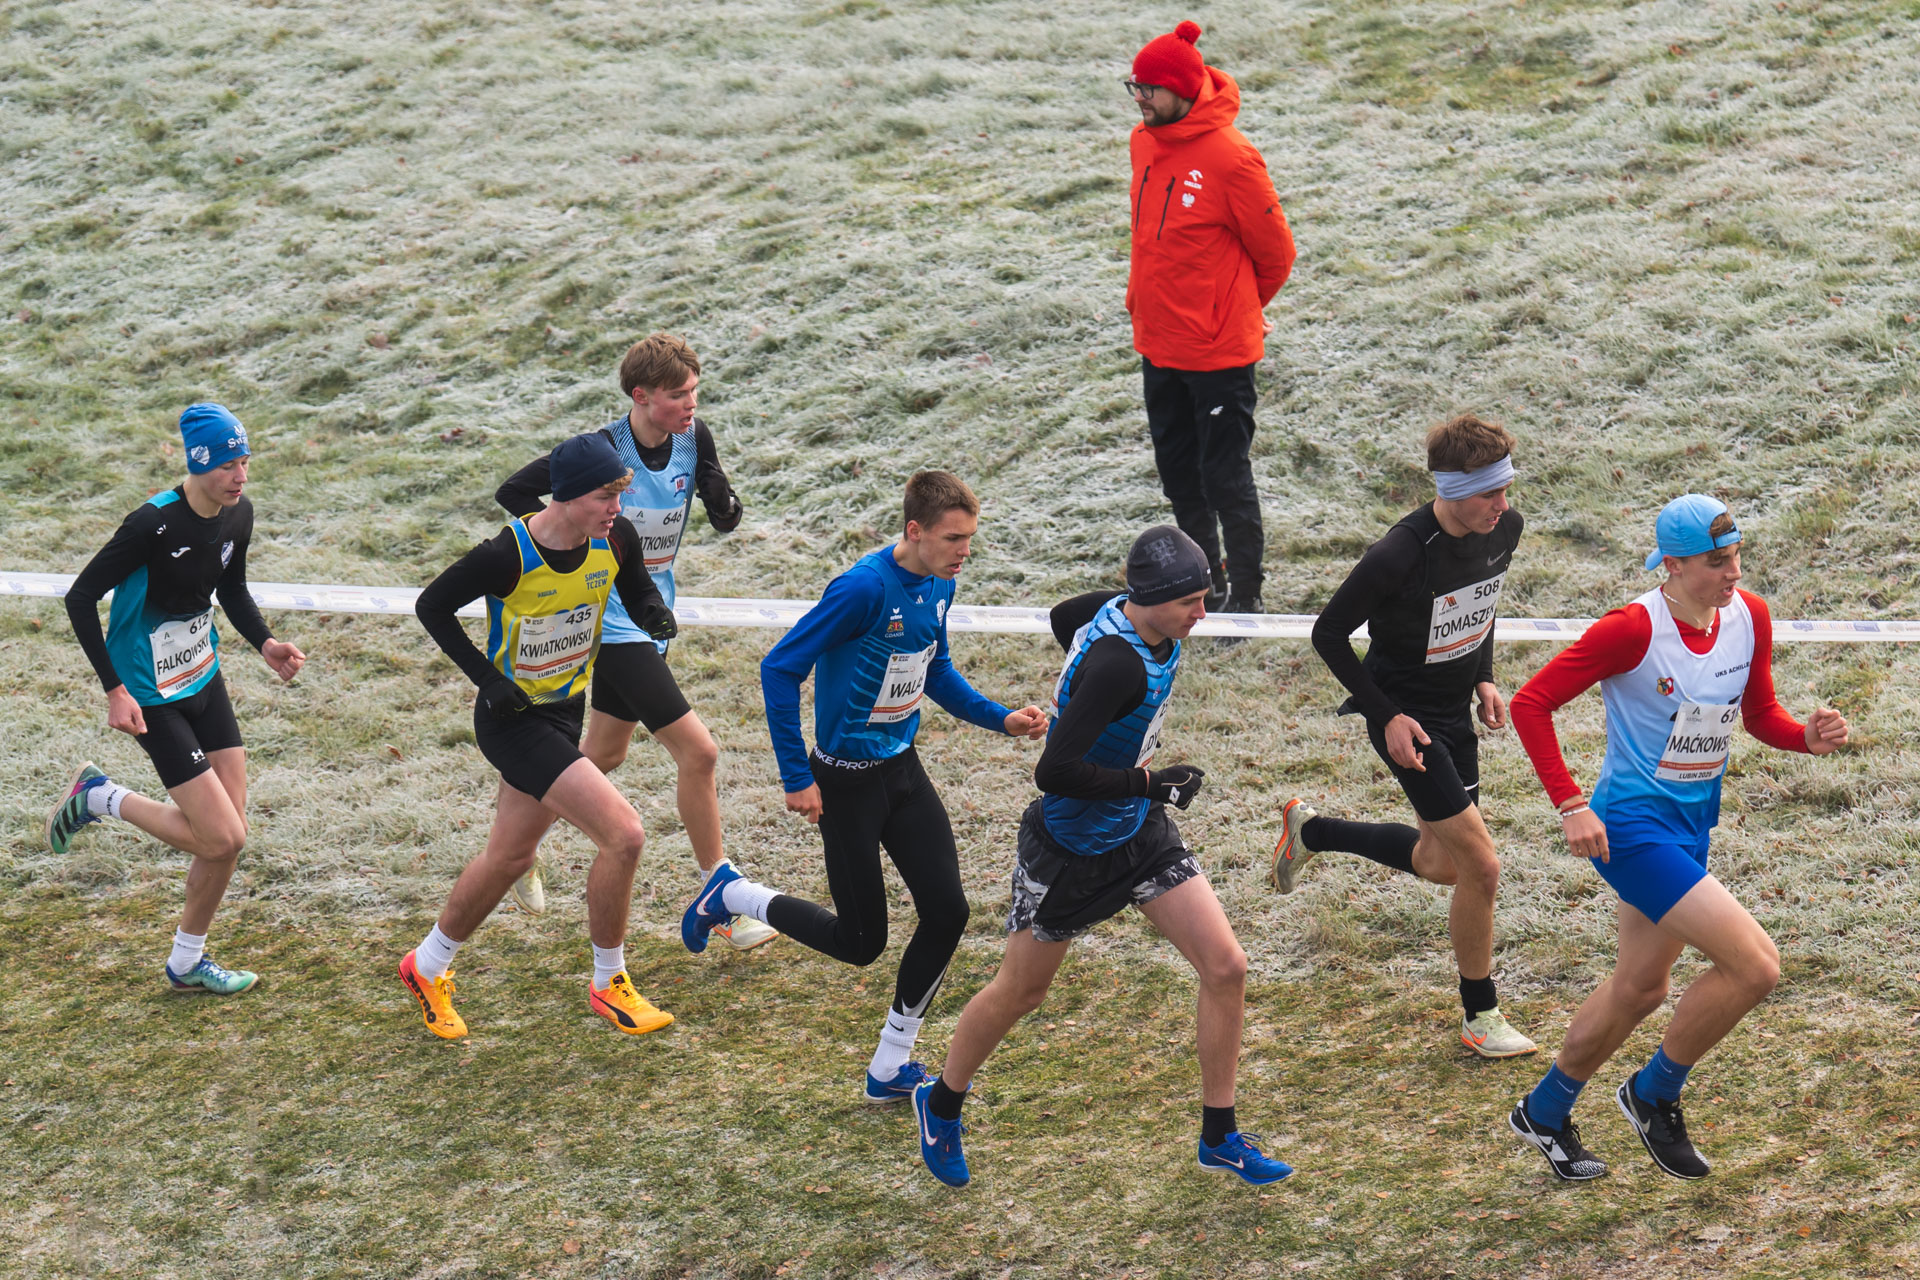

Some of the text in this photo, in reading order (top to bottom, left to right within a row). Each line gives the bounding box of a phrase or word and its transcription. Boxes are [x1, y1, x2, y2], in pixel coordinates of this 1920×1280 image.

[663, 510, 682, 526] 646
[585, 569, 609, 582] SAMBOR
[586, 578, 608, 590] TCZEW
[1474, 579, 1500, 600] 508
[189, 613, 209, 634] 612
[565, 607, 592, 625] 435
[520, 628, 592, 658] KWIATKOWSKI
[156, 632, 209, 676] FALKOWSKI
[1448, 646, 1467, 659] LUBIN
[537, 662, 573, 679] LUBIN 2025
[1715, 669, 1728, 678] UKS
[175, 678, 192, 690] LUBIN
[813, 745, 835, 765] NIKE
[835, 759, 869, 770] PRO
[1678, 771, 1713, 780] LUBIN 2025
